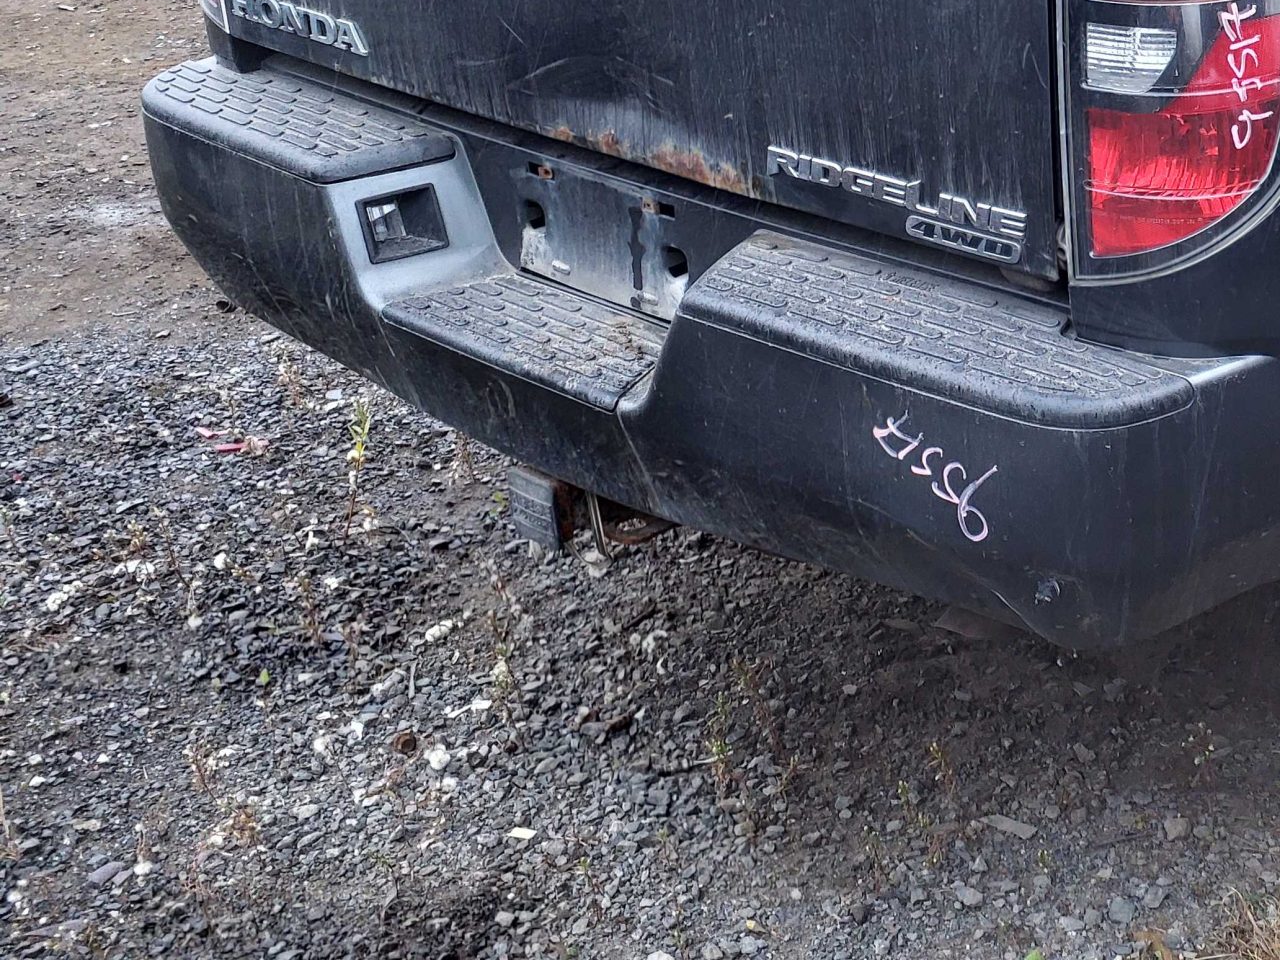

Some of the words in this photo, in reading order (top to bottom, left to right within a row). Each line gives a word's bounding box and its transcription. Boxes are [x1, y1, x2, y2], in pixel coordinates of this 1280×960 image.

[1217, 2, 1274, 150] 95517
[767, 145, 1028, 240] RIDGELINE
[908, 217, 1021, 263] 4WD
[872, 409, 999, 542] 95517
